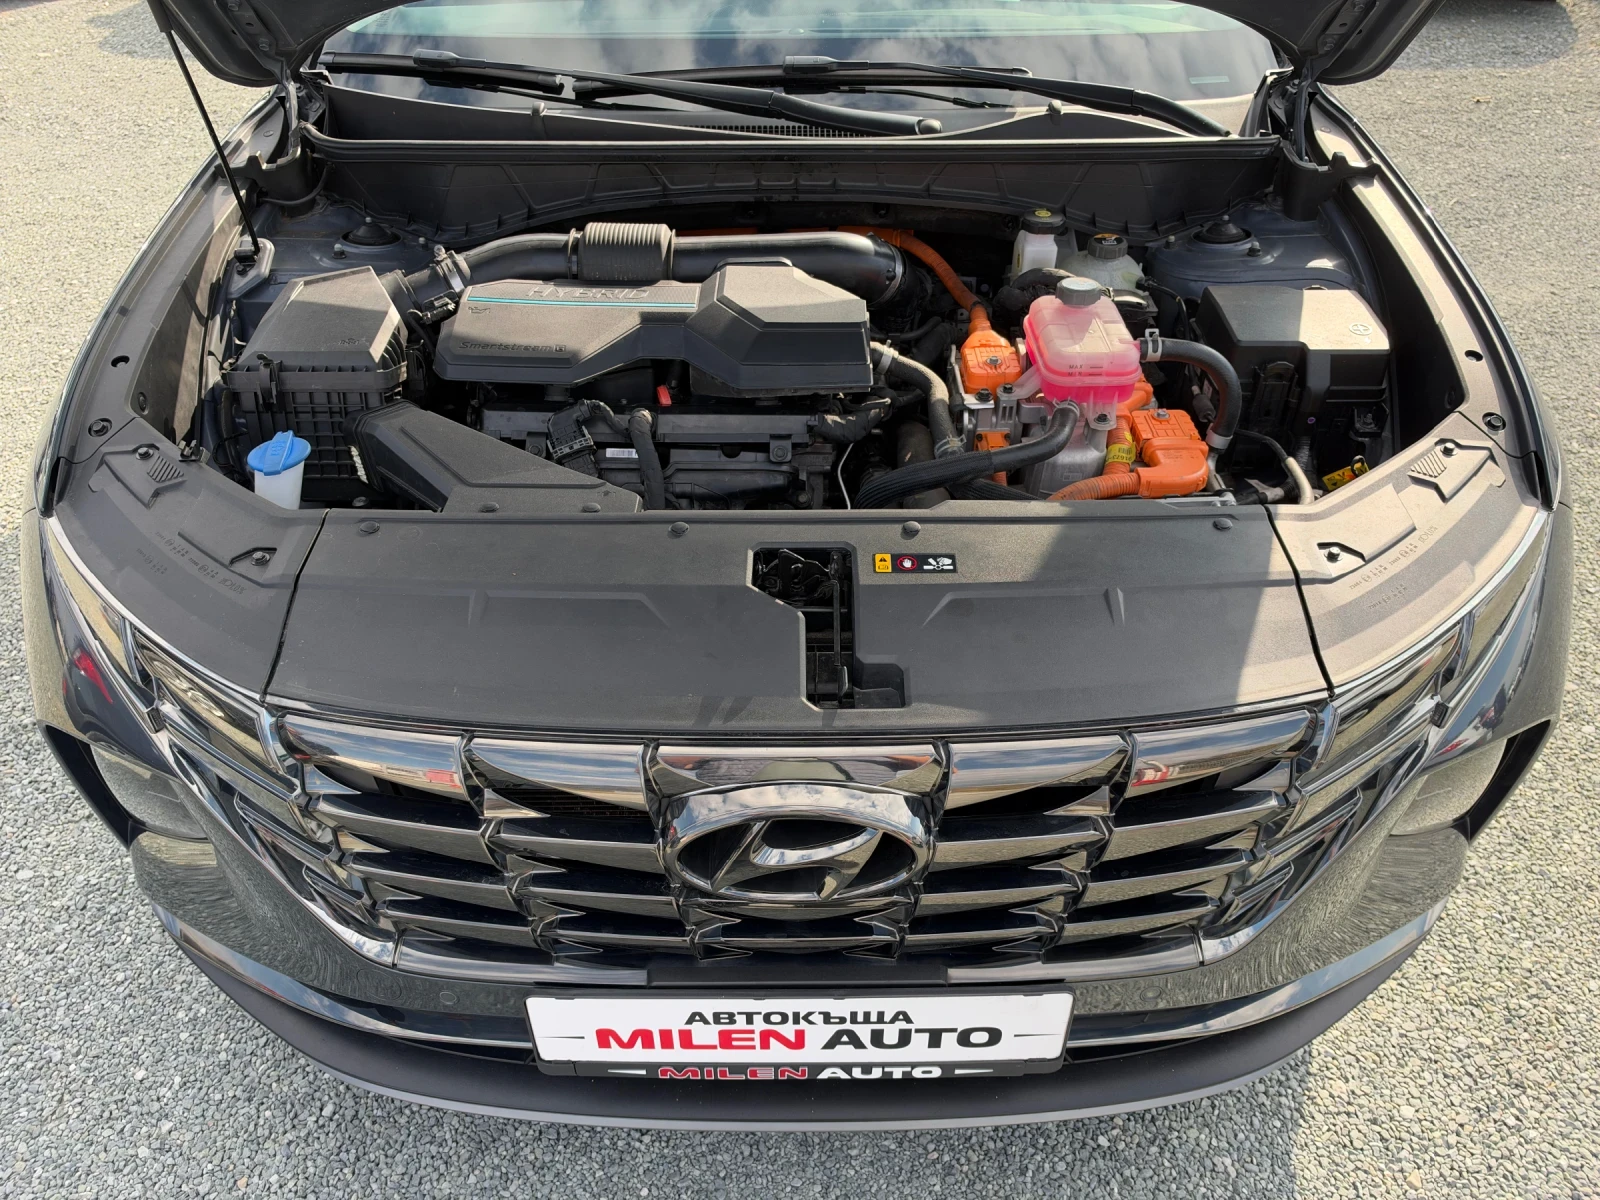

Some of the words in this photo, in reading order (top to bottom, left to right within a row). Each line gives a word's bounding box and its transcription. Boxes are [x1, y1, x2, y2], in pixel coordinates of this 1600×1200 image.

[526, 286, 650, 300] HYBRID
[458, 341, 551, 352] Smartstream
[684, 1010, 915, 1026] АВТОКЪША
[595, 1028, 806, 1051] MILEN
[820, 1026, 1003, 1050] AUTO
[658, 1066, 808, 1081] MILEN
[816, 1065, 943, 1080] AUTO
